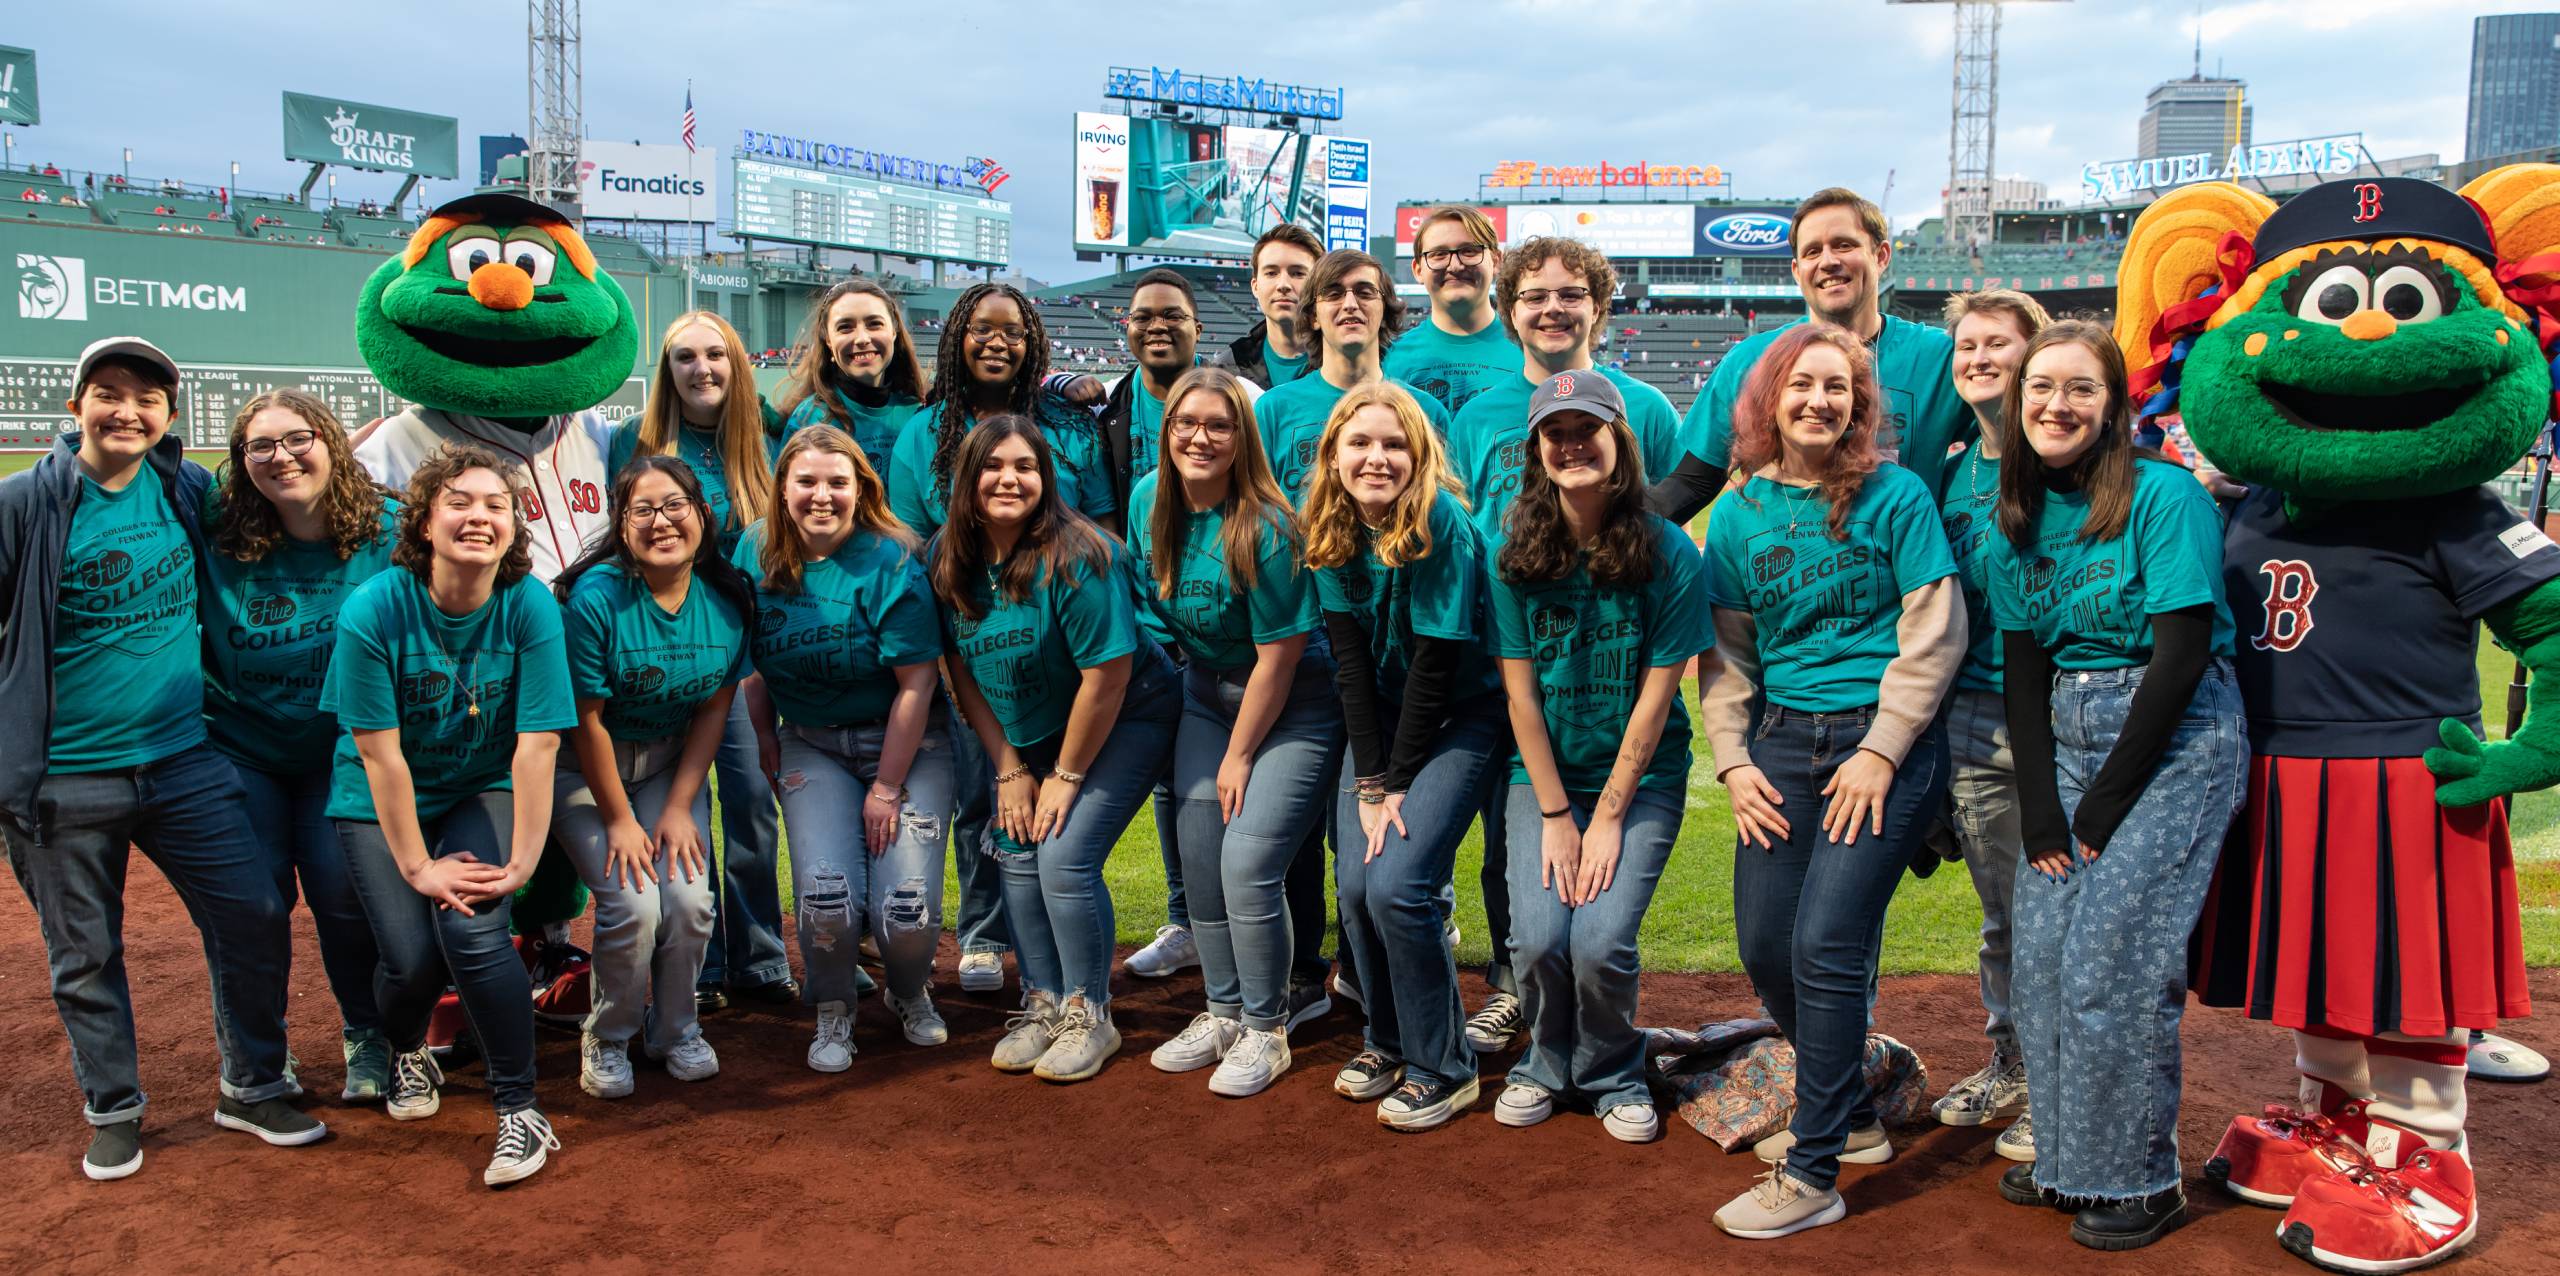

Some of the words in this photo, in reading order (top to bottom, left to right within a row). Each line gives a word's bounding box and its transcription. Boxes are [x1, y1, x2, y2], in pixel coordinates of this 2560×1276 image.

[1152, 66, 1343, 119] MassMutual
[330, 126, 415, 151] DRAFT
[1080, 131, 1126, 146] IRVING
[343, 144, 414, 168] KINGS
[744, 129, 816, 162] BANK
[824, 143, 855, 168] OF
[862, 151, 965, 188] AMERICA
[2081, 152, 2219, 200] SAMUEL
[2220, 137, 2358, 179] ADAMS
[602, 169, 704, 195] Fanatics
[1541, 166, 1596, 187] new
[1600, 160, 1722, 187] balance
[2352, 183, 2384, 223] B
[1723, 218, 1782, 242] Ford
[94, 276, 247, 312] BETMGM
[700, 273, 748, 288] ABIOMED
[7, 377, 15, 386] 5
[17, 377, 25, 386] 6
[30, 377, 37, 386] 7
[40, 377, 48, 387] 8
[48, 378, 57, 387] 9
[61, 378, 71, 387] 10
[28, 366, 74, 376] PARK
[199, 372, 239, 380] LEAGUE
[308, 375, 354, 383] NATIONAL
[1554, 375, 1575, 398] B
[209, 393, 224, 401] LAA
[209, 401, 225, 409] SEA
[30, 422, 53, 431] OUT
[211, 419, 226, 427] TEX
[210, 436, 227, 444] HOU
[118, 529, 159, 545] FENWAY
[80, 551, 132, 590] Five
[86, 542, 192, 613] OLLEGES
[1748, 545, 1869, 613] COLLEGES
[1752, 545, 1795, 585] Five
[2024, 556, 2056, 596] Five
[288, 586, 334, 595] FENWAY
[1816, 570, 1870, 618] ONE
[2028, 559, 2116, 621] OLLEGES
[2250, 559, 2319, 652] B
[249, 594, 295, 627] Five
[1534, 605, 1577, 640] Five
[2073, 585, 2120, 633] ONE
[228, 611, 338, 650] COLLEG
[753, 623, 845, 657] OLLEGES
[959, 627, 1035, 659] OLLEGES
[1538, 618, 1641, 663] OLLEGES
[657, 653, 697, 662] FENWAY
[996, 650, 1033, 687] ONE
[1593, 646, 1638, 681] ONE
[403, 670, 449, 706] Five
[622, 664, 665, 695] Five
[1546, 684, 1632, 698] OMMUNIT
